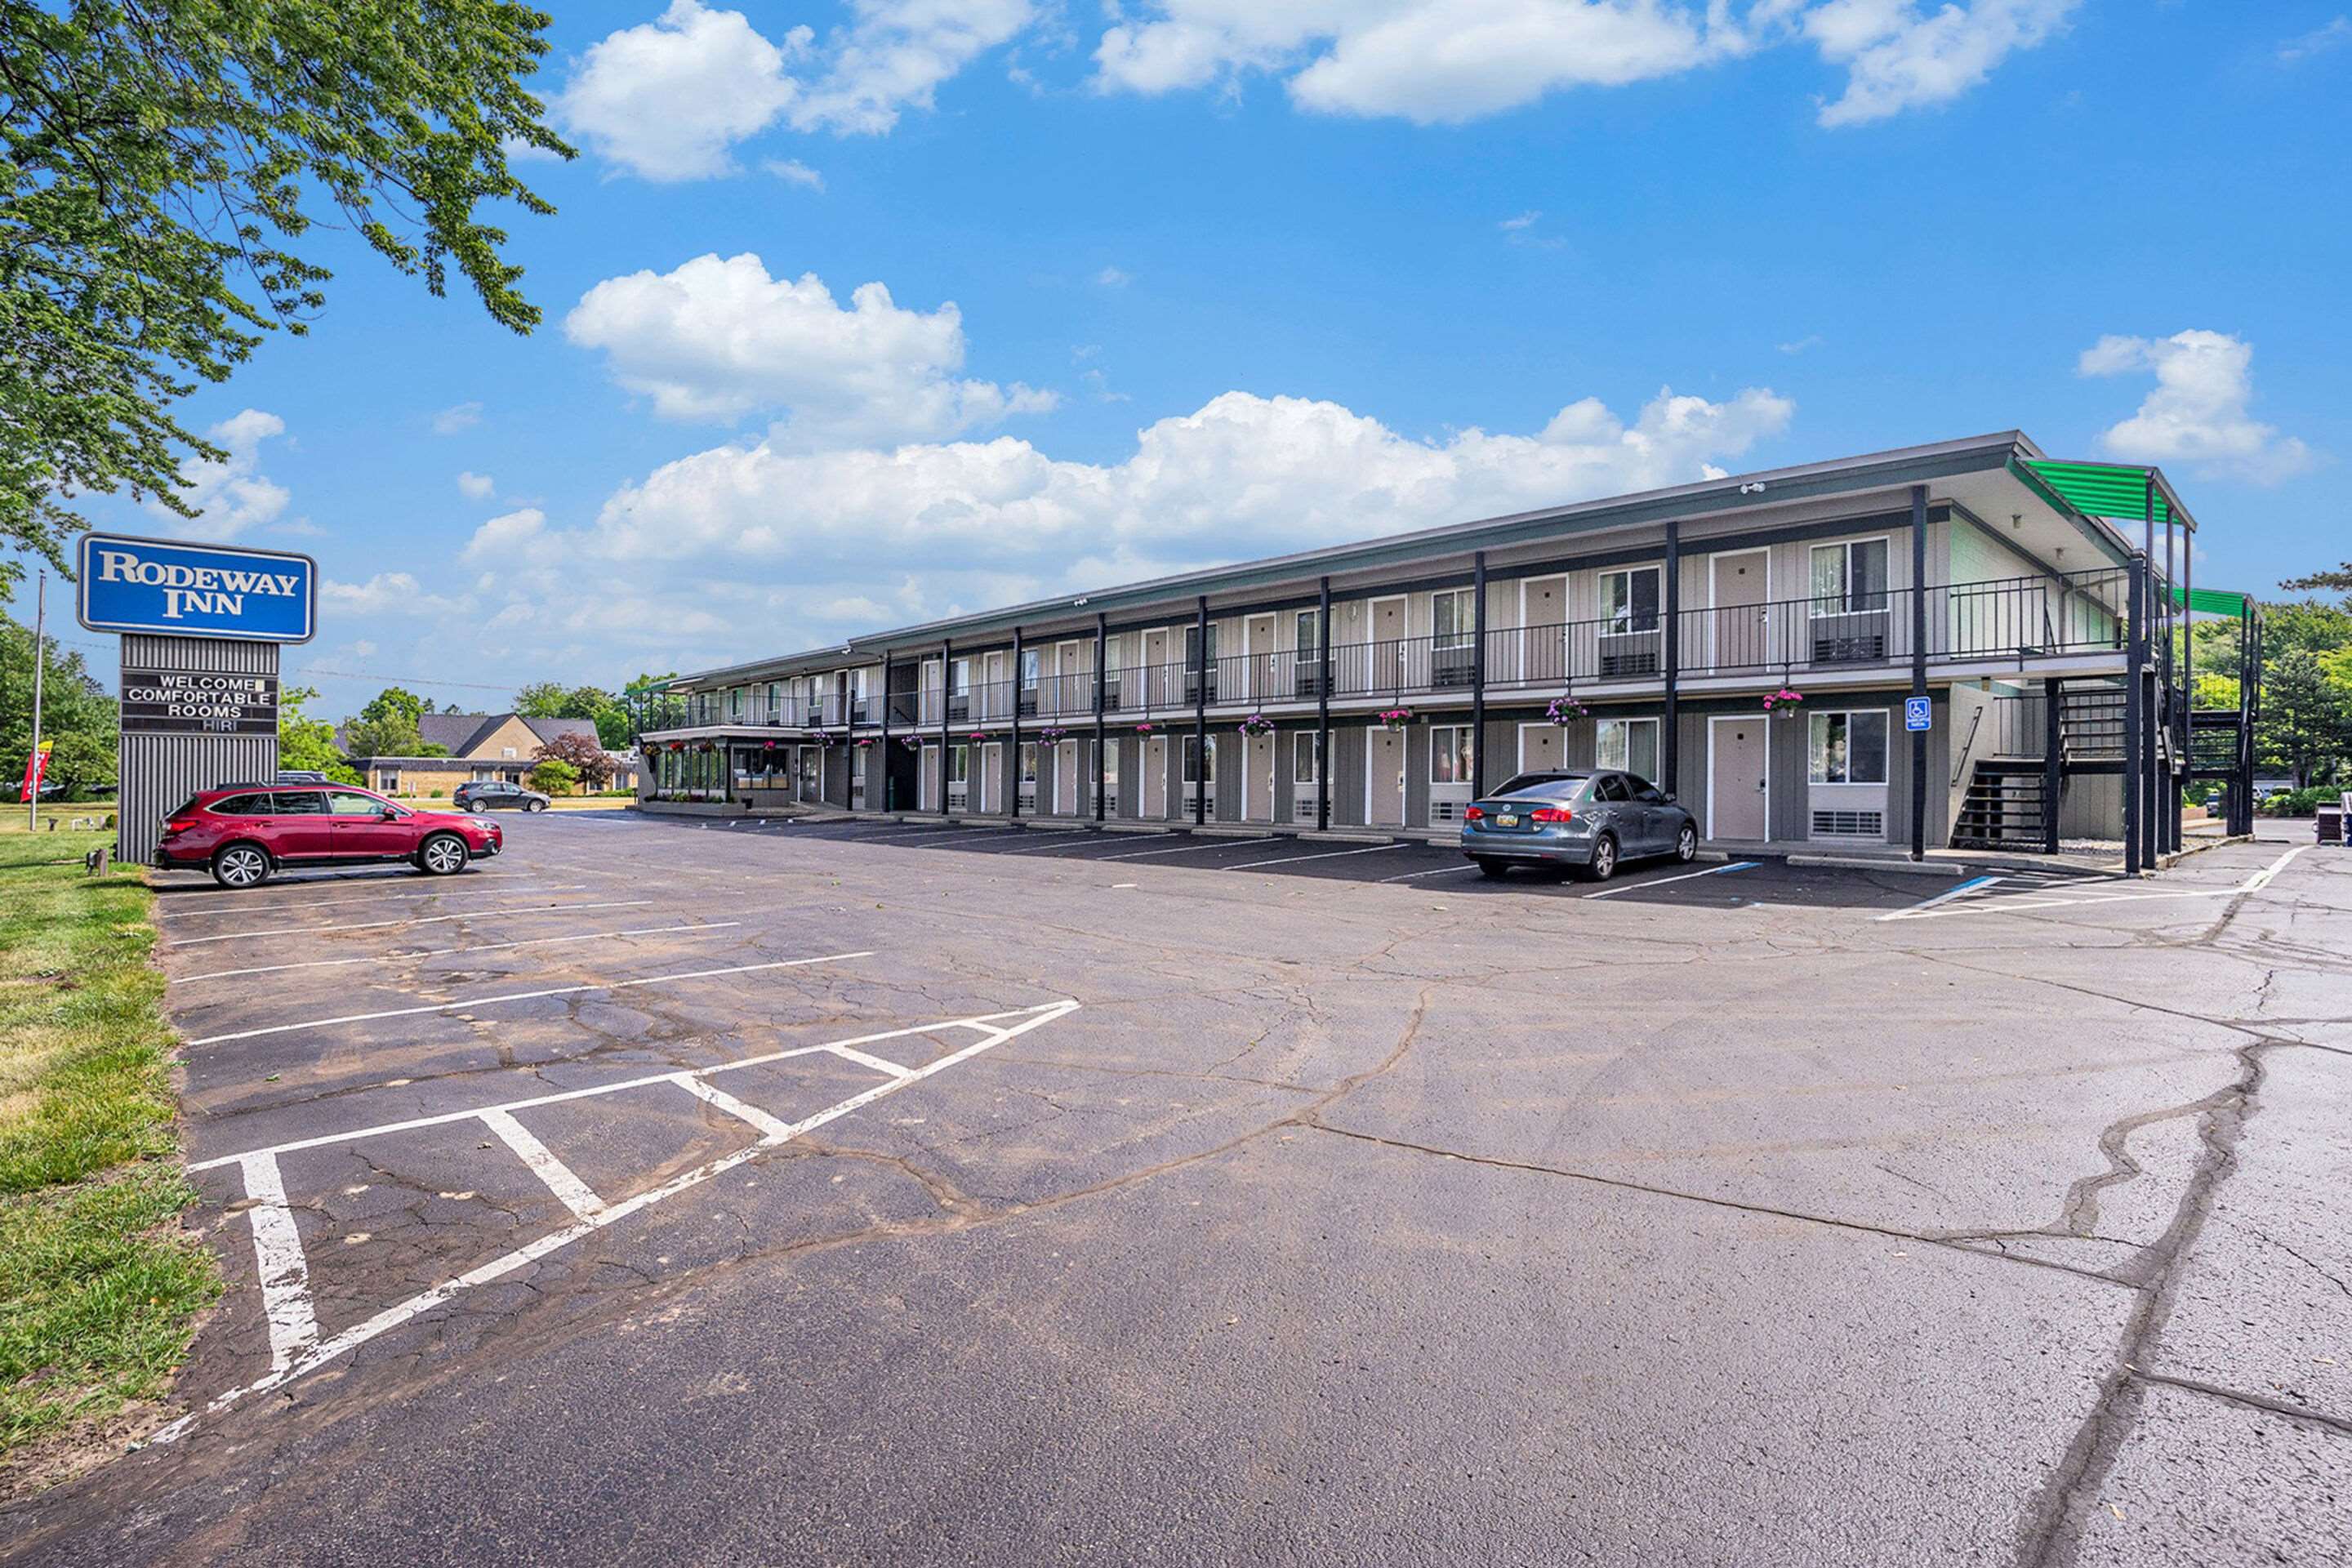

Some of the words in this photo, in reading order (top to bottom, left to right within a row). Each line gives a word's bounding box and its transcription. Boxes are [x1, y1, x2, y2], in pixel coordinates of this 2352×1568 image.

[98, 550, 300, 597] RODEWAY
[163, 588, 244, 618] INN
[159, 675, 256, 691] WELCOME
[128, 688, 271, 705] COMFORTABLE
[168, 704, 242, 719] ROOMS
